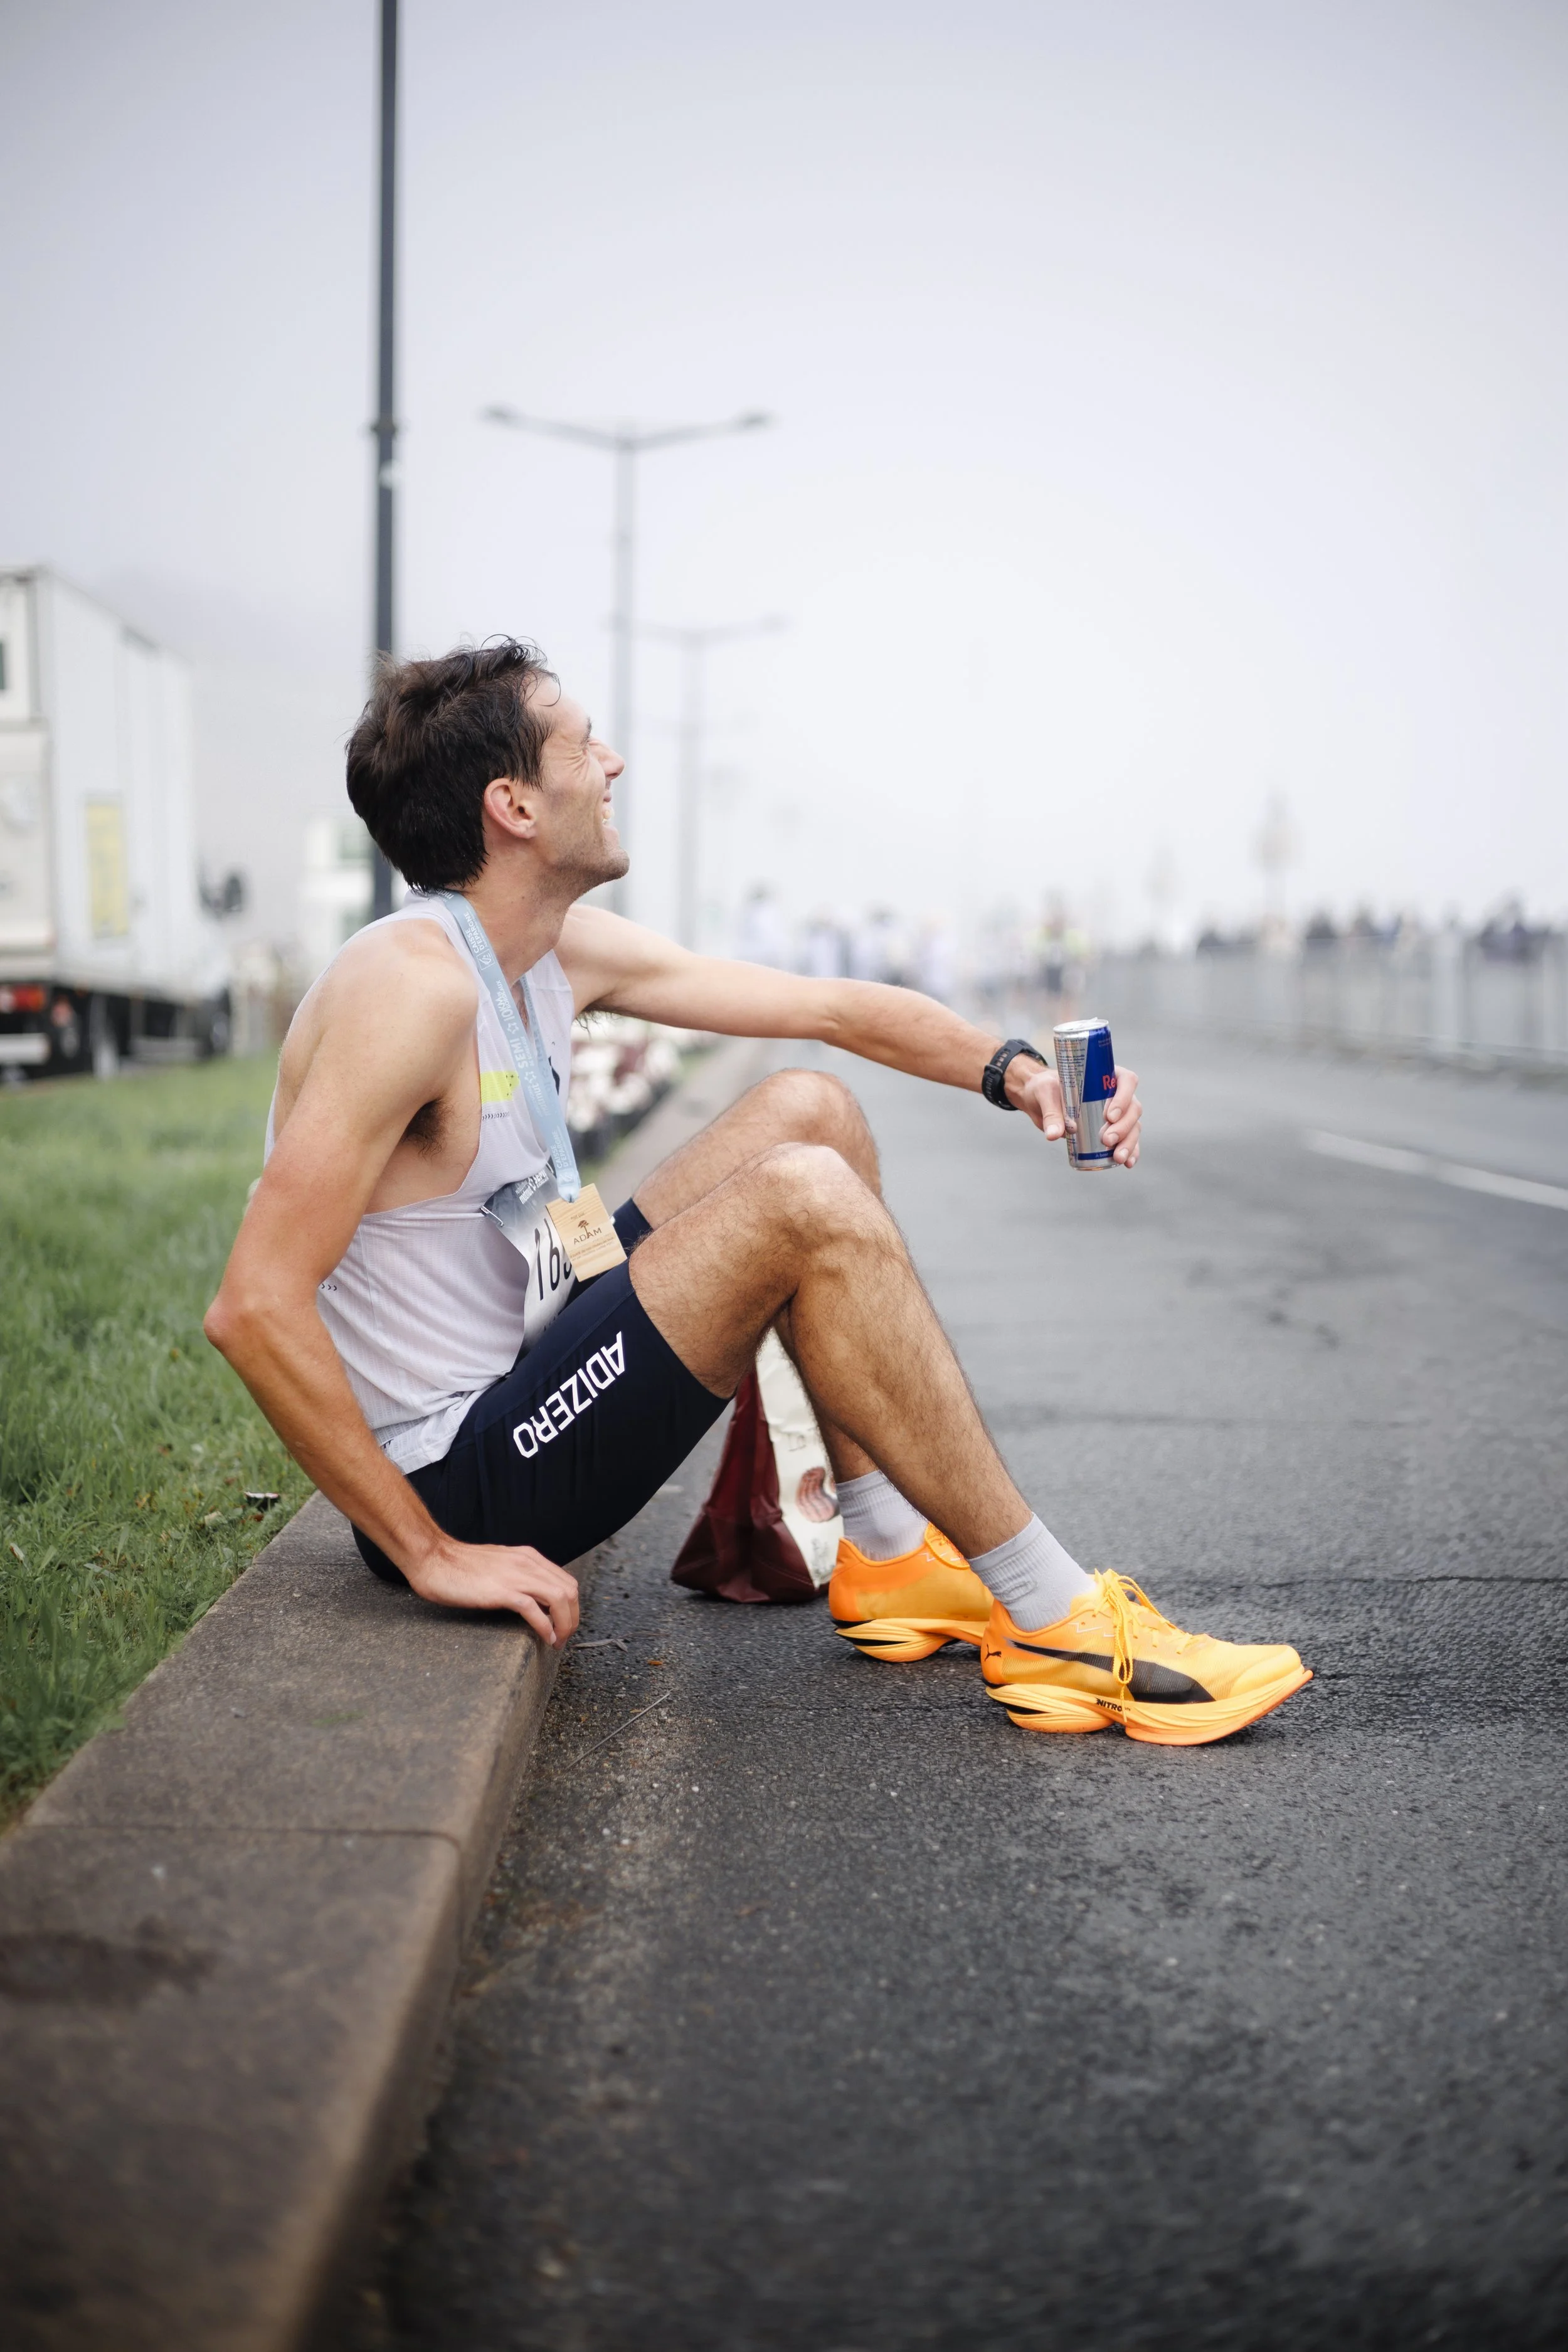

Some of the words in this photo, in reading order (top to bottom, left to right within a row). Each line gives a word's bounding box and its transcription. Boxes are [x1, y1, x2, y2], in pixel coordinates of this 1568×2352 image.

[464, 911, 485, 951] D'EPARGNE
[465, 928, 479, 953] CAISSE
[509, 1037, 529, 1069] SEMI
[1103, 1074, 1117, 1090] Re
[551, 1144, 563, 1169] CAISSE
[552, 1130, 569, 1168] D'EPARGNE
[574, 1227, 602, 1244] ADAM
[513, 1331, 625, 1458] ADIZERO
[1095, 1697, 1122, 1712] NITRO
